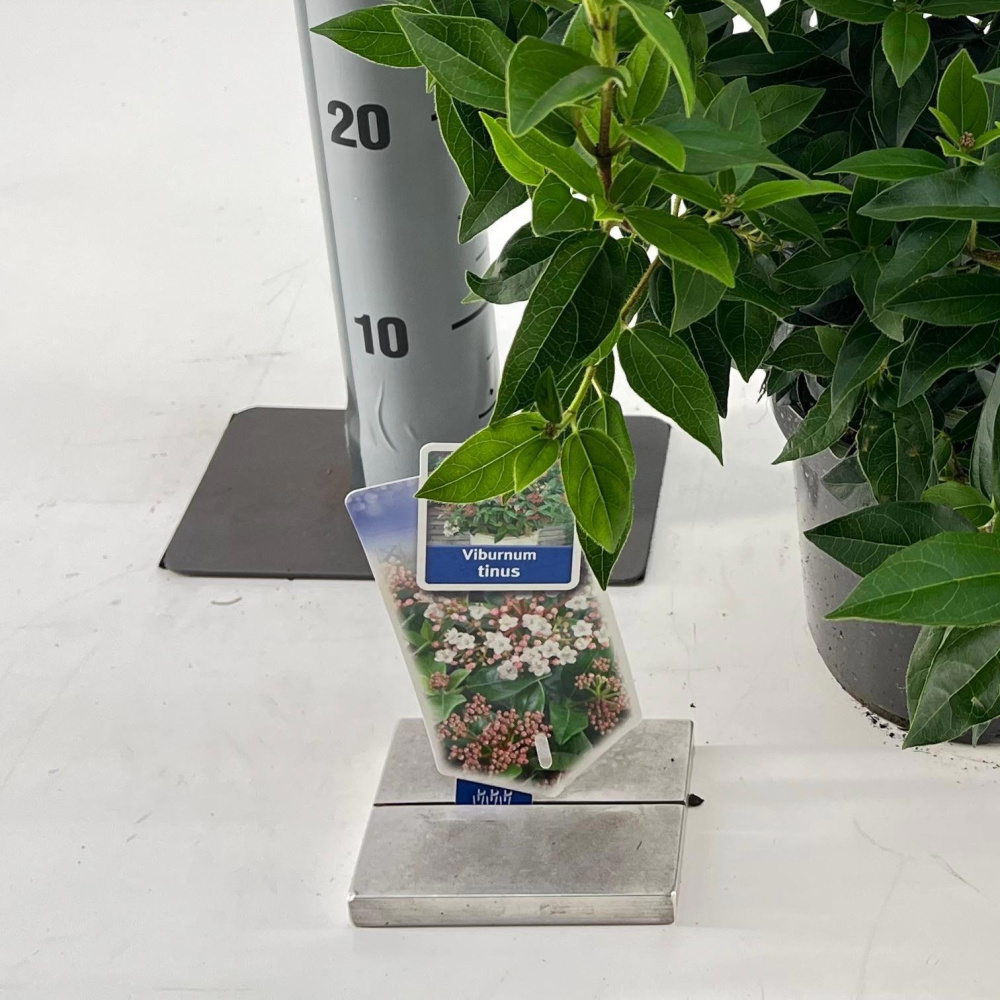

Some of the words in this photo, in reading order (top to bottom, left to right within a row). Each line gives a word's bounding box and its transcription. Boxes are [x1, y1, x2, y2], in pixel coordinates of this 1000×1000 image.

[327, 100, 391, 151] 20
[353, 314, 409, 360] 10
[461, 548, 537, 561] Viburnum
[477, 564, 521, 578] tinus
